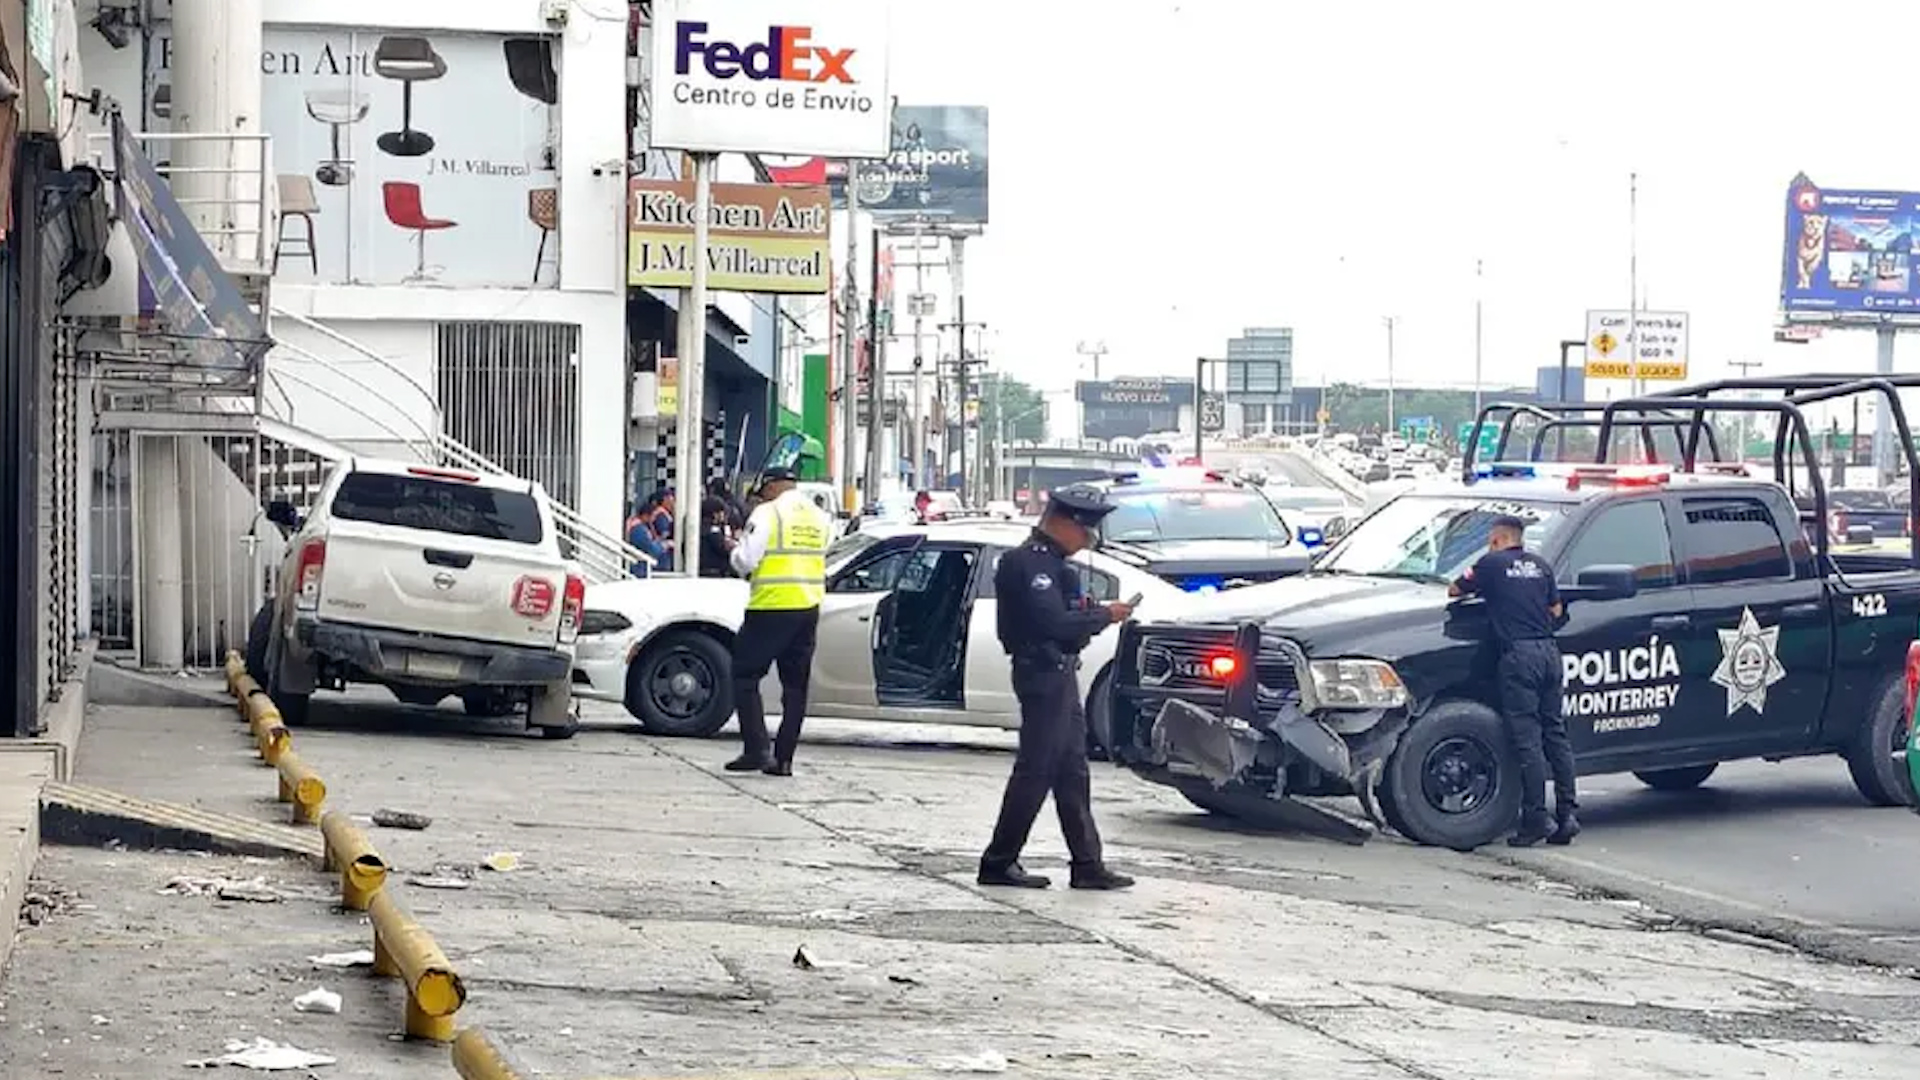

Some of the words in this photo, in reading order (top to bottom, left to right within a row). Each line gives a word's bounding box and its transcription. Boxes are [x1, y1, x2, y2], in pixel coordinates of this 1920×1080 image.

[314, 41, 373, 76] Art
[675, 20, 858, 84] FedEx
[673, 82, 757, 107] Centro
[765, 87, 796, 109] de
[771, 198, 826, 232] Art
[637, 243, 695, 274] J.M.
[706, 247, 821, 277] Villarreal
[1852, 593, 1887, 617] 422
[1561, 634, 1680, 688] POLICÍA
[1560, 683, 1680, 717] MONTERREY
